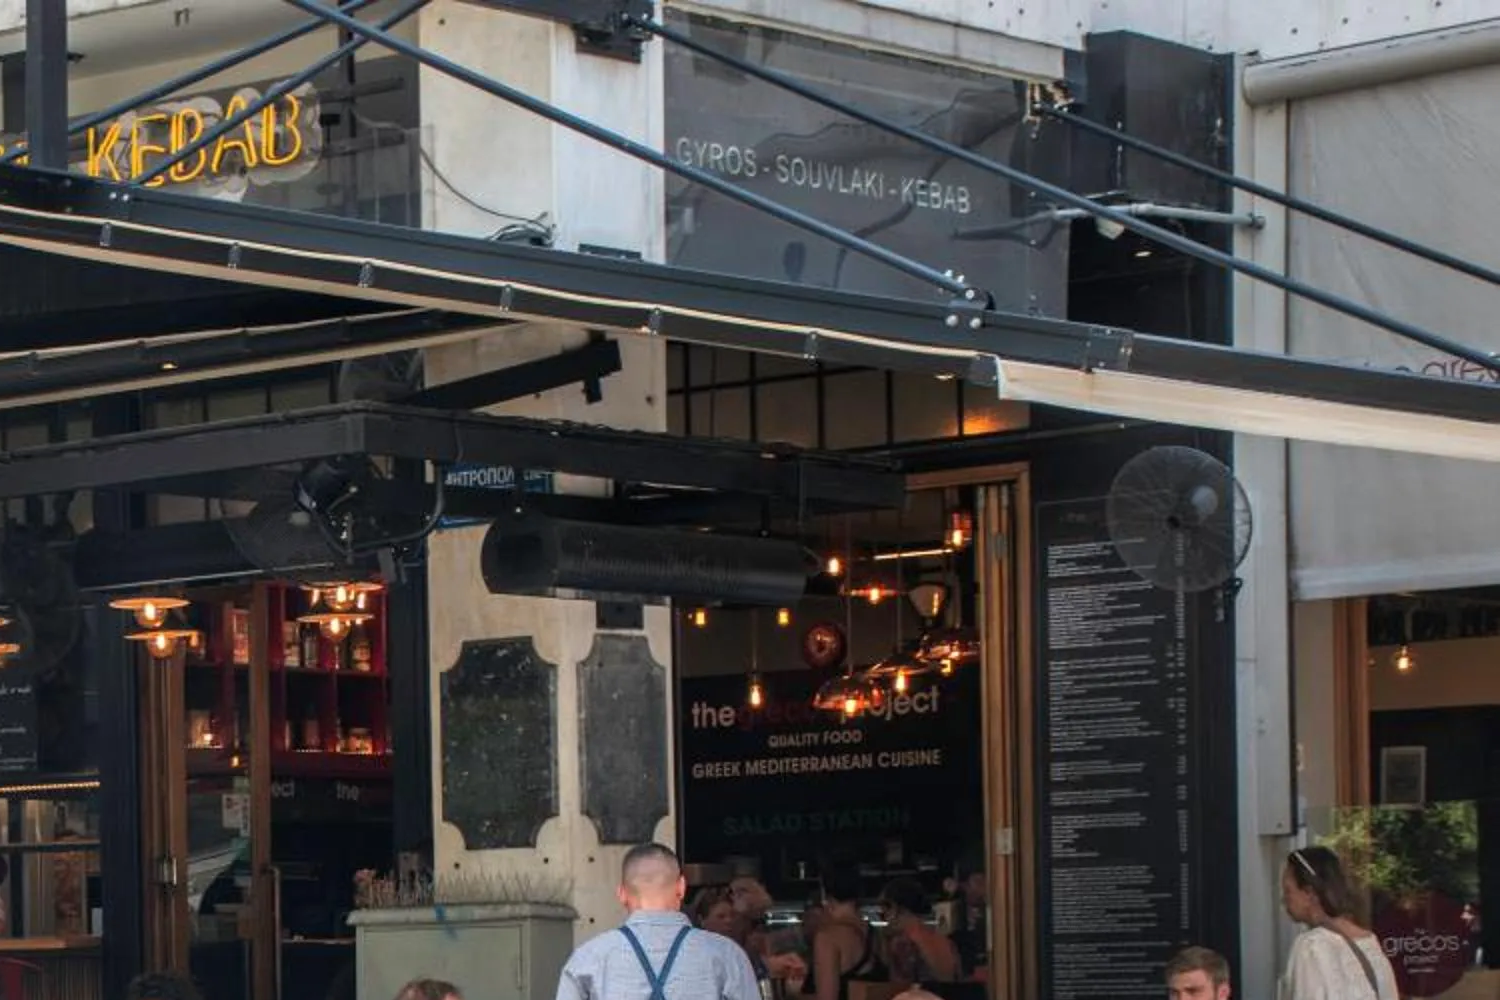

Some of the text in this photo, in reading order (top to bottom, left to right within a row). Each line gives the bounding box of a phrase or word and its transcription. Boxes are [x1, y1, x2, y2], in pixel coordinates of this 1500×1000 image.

[86, 93, 303, 188] KEBAB
[676, 137, 757, 177] GYROS
[775, 154, 884, 198] SOUVLAKI
[901, 177, 972, 214] KEBAB
[691, 701, 735, 729] the
[767, 730, 862, 749] QUALITY FOOD
[691, 749, 942, 779] GREEK MEDITERRANEAN CUISINE
[1382, 935, 1461, 957] grecos
